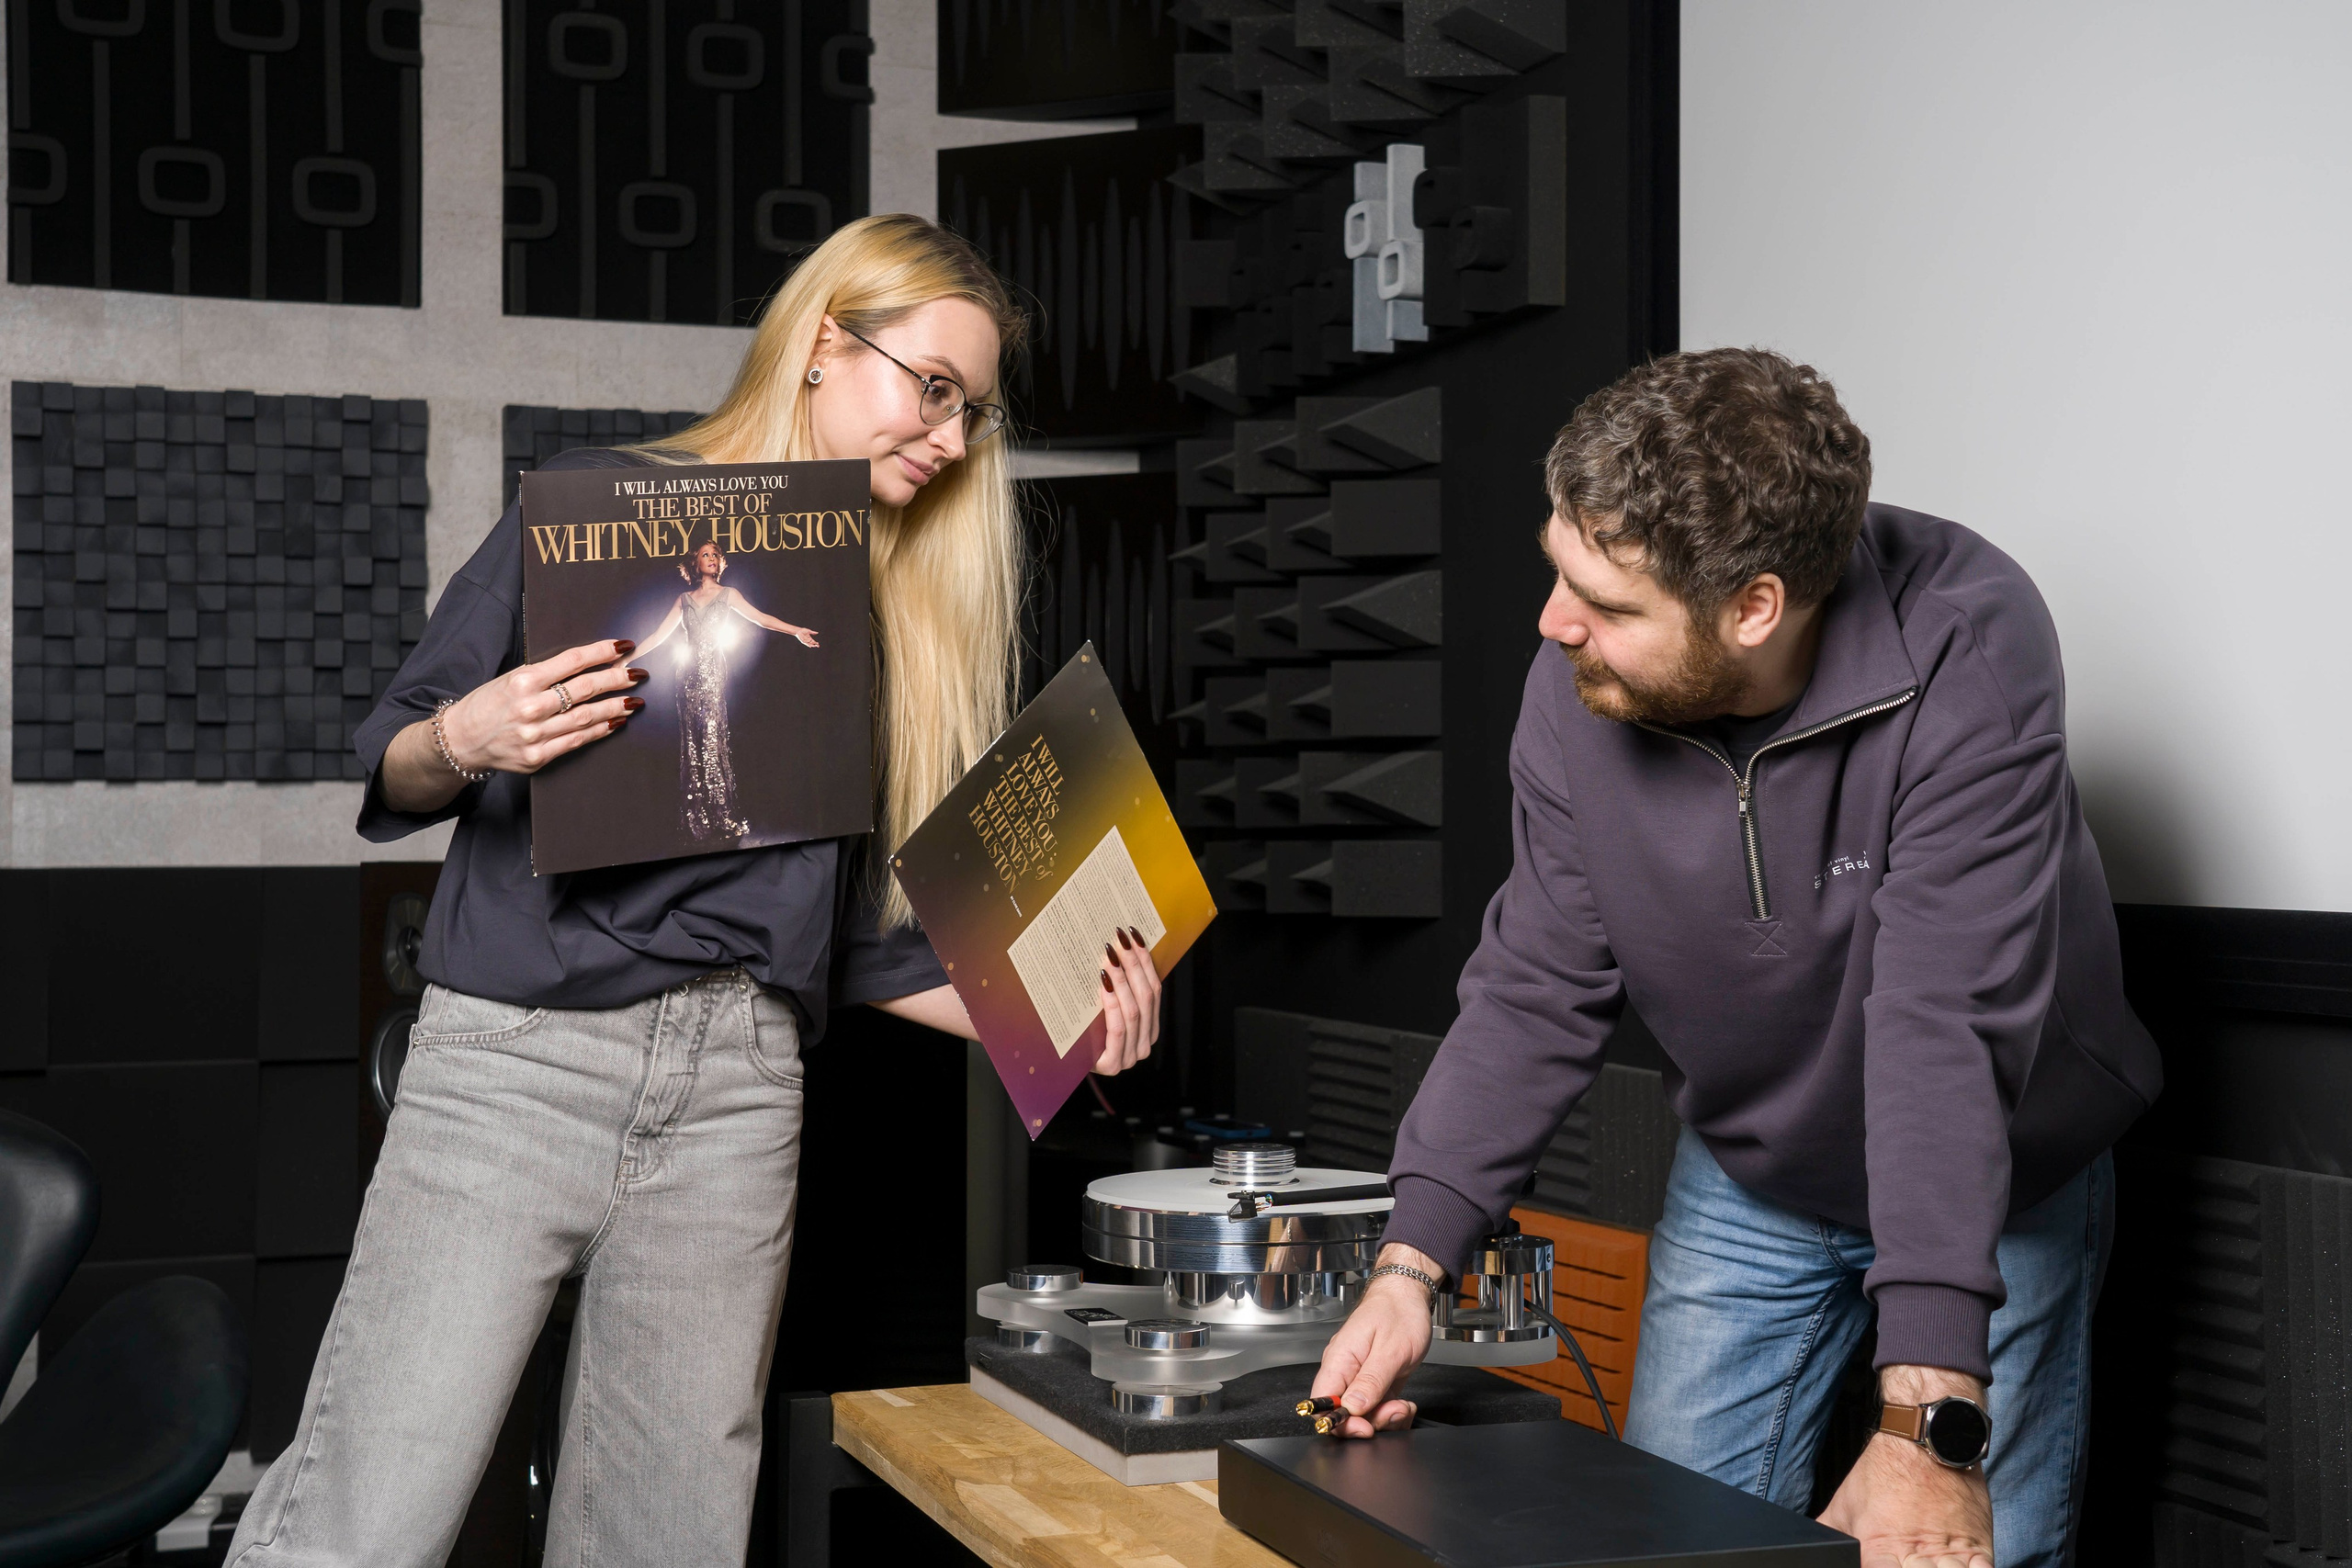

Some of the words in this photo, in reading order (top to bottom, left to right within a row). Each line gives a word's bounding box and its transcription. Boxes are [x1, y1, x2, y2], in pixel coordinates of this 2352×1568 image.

[615, 482, 621, 496] I
[623, 480, 661, 495] WILL
[662, 478, 717, 494] ALWAYS
[719, 477, 757, 491] LOVE
[760, 475, 789, 490] YOU
[632, 497, 681, 520] THE
[684, 494, 740, 517] BEST
[743, 493, 773, 514] OF
[528, 518, 701, 565] WHITNEY
[708, 509, 866, 554] HOUSTON
[1031, 733, 1045, 750] I
[1037, 741, 1065, 796] WILL
[1005, 760, 1038, 816] LOVE
[1017, 750, 1060, 819] ALWAYS
[967, 802, 1021, 894] HOUSTON
[982, 787, 1034, 878] WHITNEY
[993, 774, 1021, 820] THE
[1013, 815, 1045, 863] BEST
[1035, 864, 1054, 881] of
